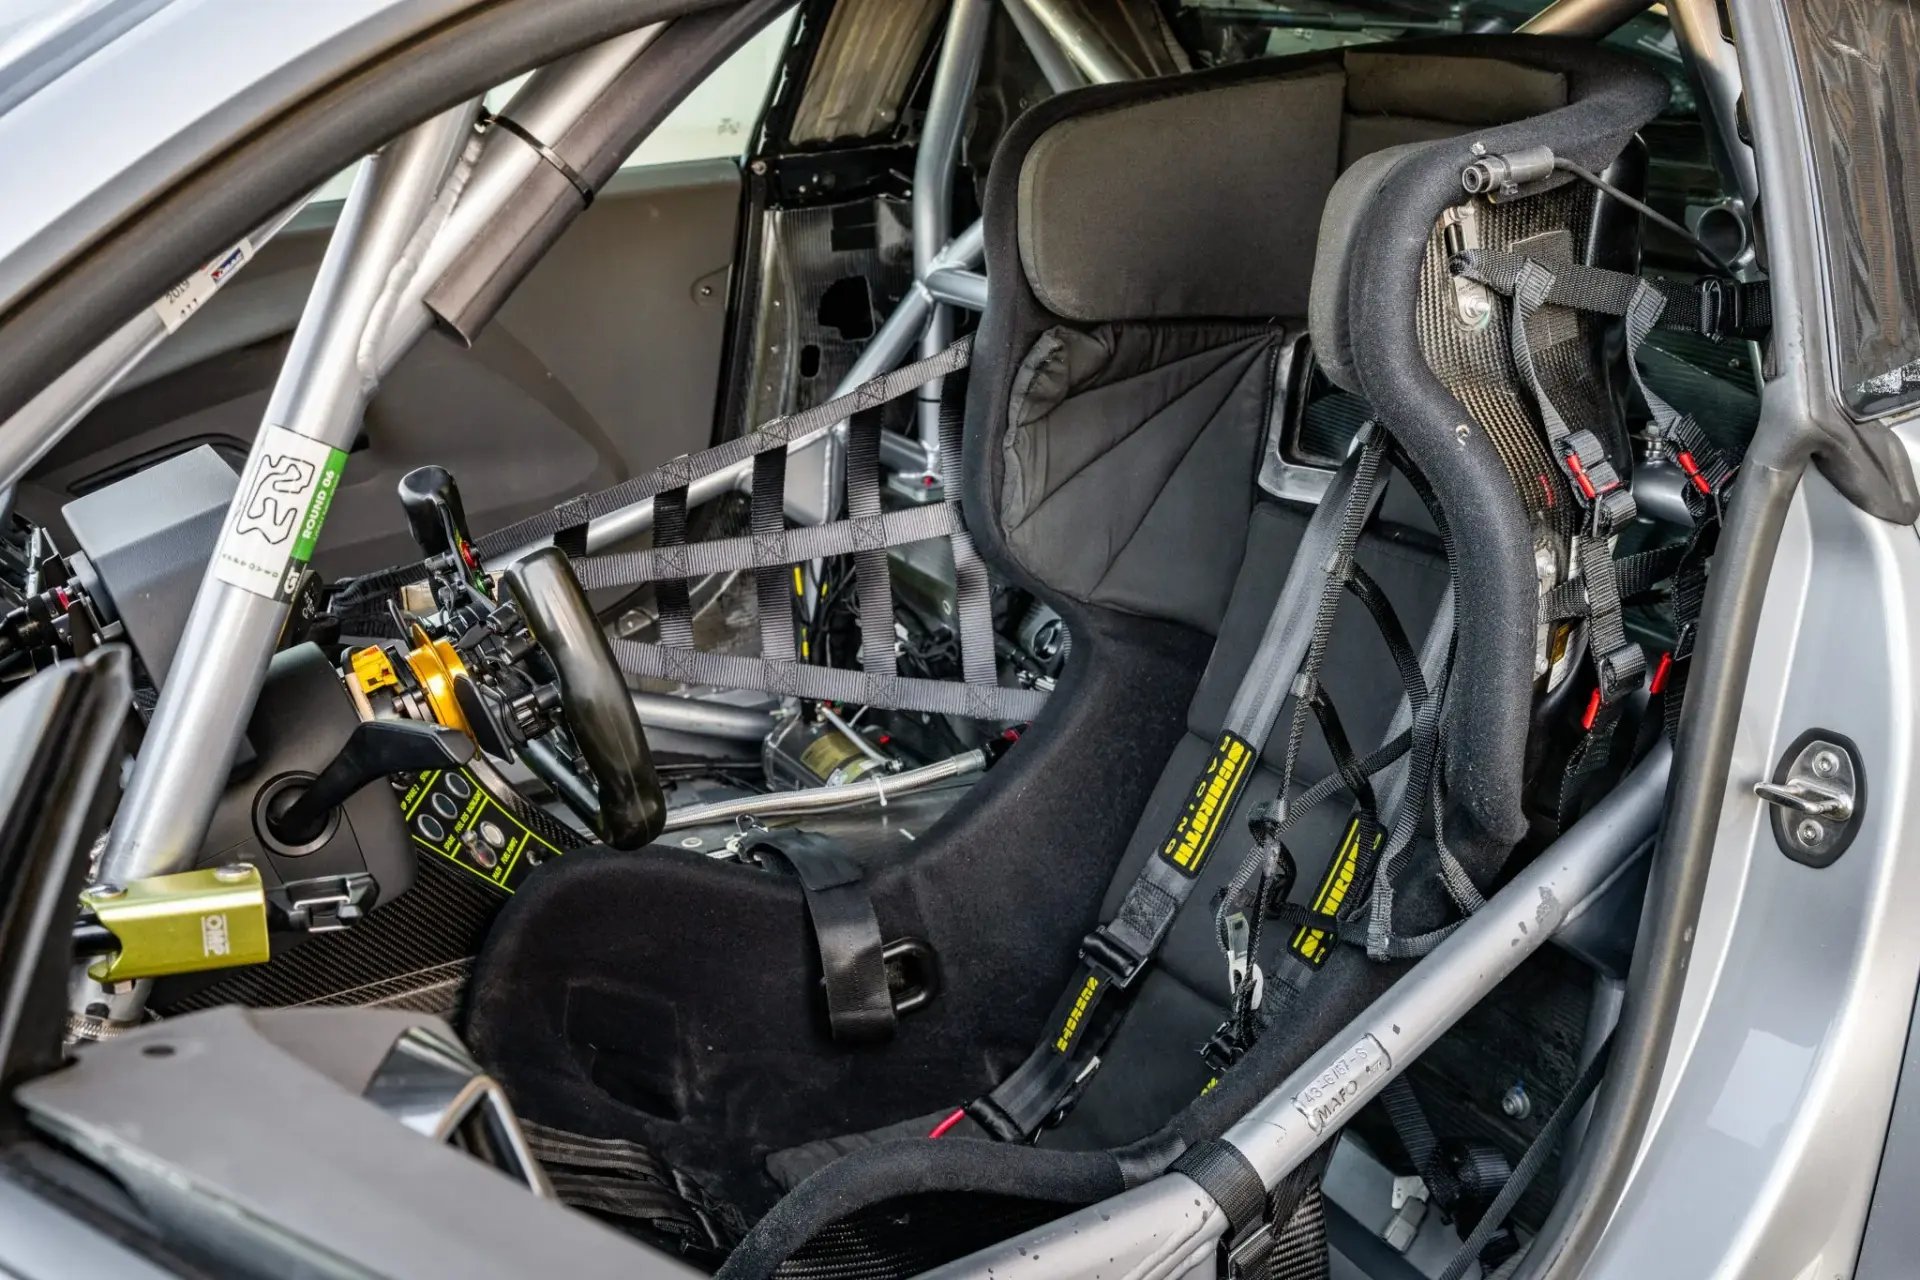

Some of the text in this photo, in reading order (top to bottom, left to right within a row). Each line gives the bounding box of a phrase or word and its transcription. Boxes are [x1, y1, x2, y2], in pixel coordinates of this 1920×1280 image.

[302, 490, 327, 539] ROUND
[323, 469, 335, 487] 06
[284, 566, 300, 594] GT
[1164, 735, 1231, 854] RACING
[1173, 740, 1245, 866] SCHROTH
[444, 834, 456, 851] SPARE
[455, 821, 464, 833] FUEL
[460, 812, 470, 823] RES
[492, 866, 502, 880] MAIN
[501, 851, 510, 864] FUEL
[202, 914, 229, 957] OMP
[1057, 976, 1099, 1052] SCHROTH
